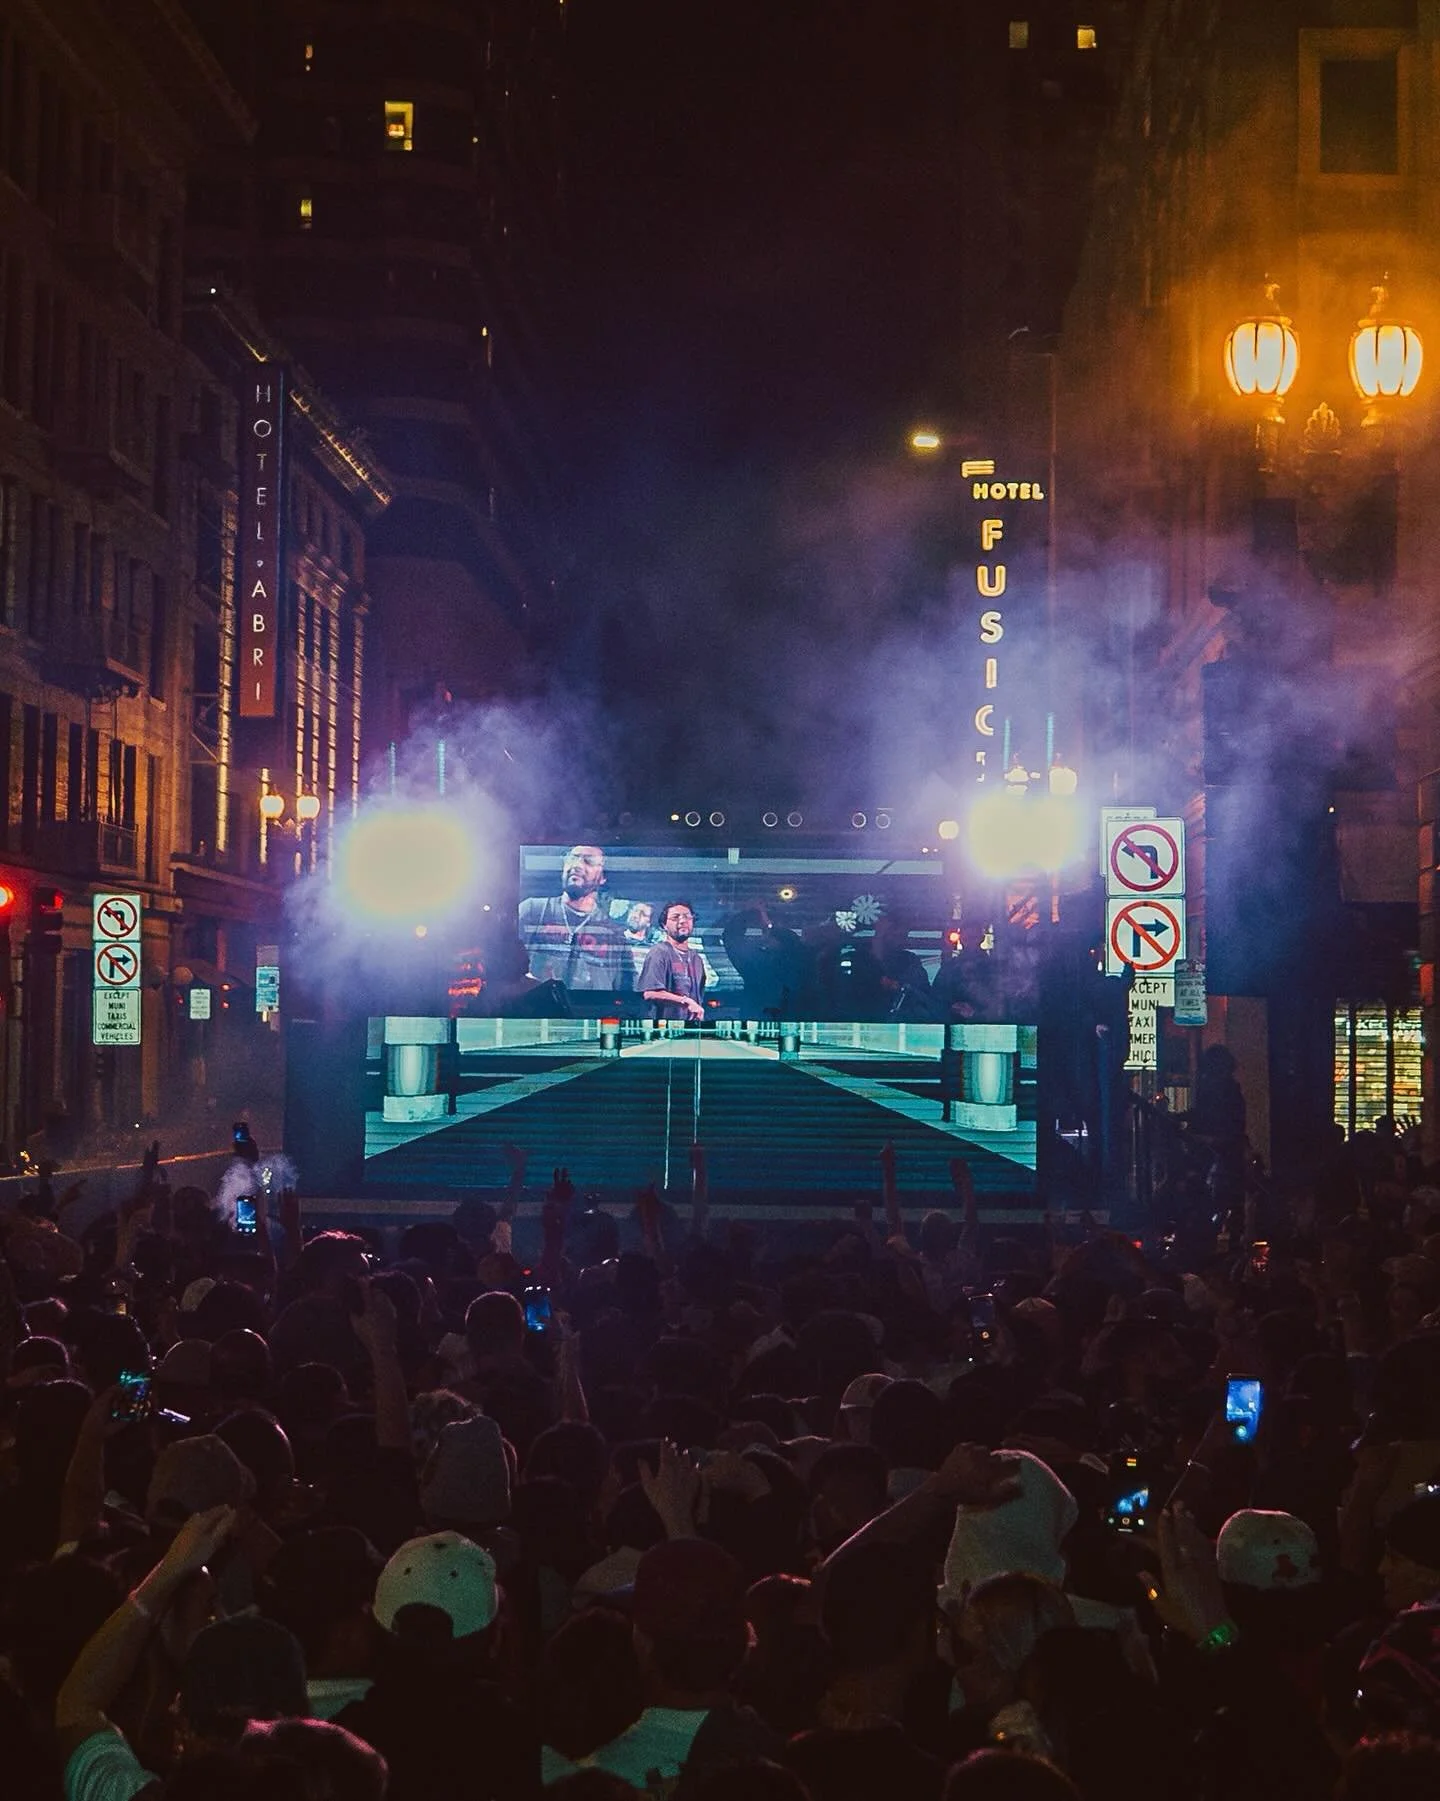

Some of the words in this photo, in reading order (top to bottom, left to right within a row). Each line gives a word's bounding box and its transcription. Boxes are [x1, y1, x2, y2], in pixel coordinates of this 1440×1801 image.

[253, 384, 272, 541] HOTEL
[972, 482, 1045, 500] HOTEL
[251, 579, 267, 701] ABRI
[1131, 982, 1168, 994] XCEPT
[103, 992, 129, 1000] EXCEPT
[108, 1002, 126, 1010] MUNI
[107, 1012, 127, 1020] TAXIS
[98, 1022, 136, 1031] COMMERCIAL
[101, 1033, 133, 1041] VEHICLES
